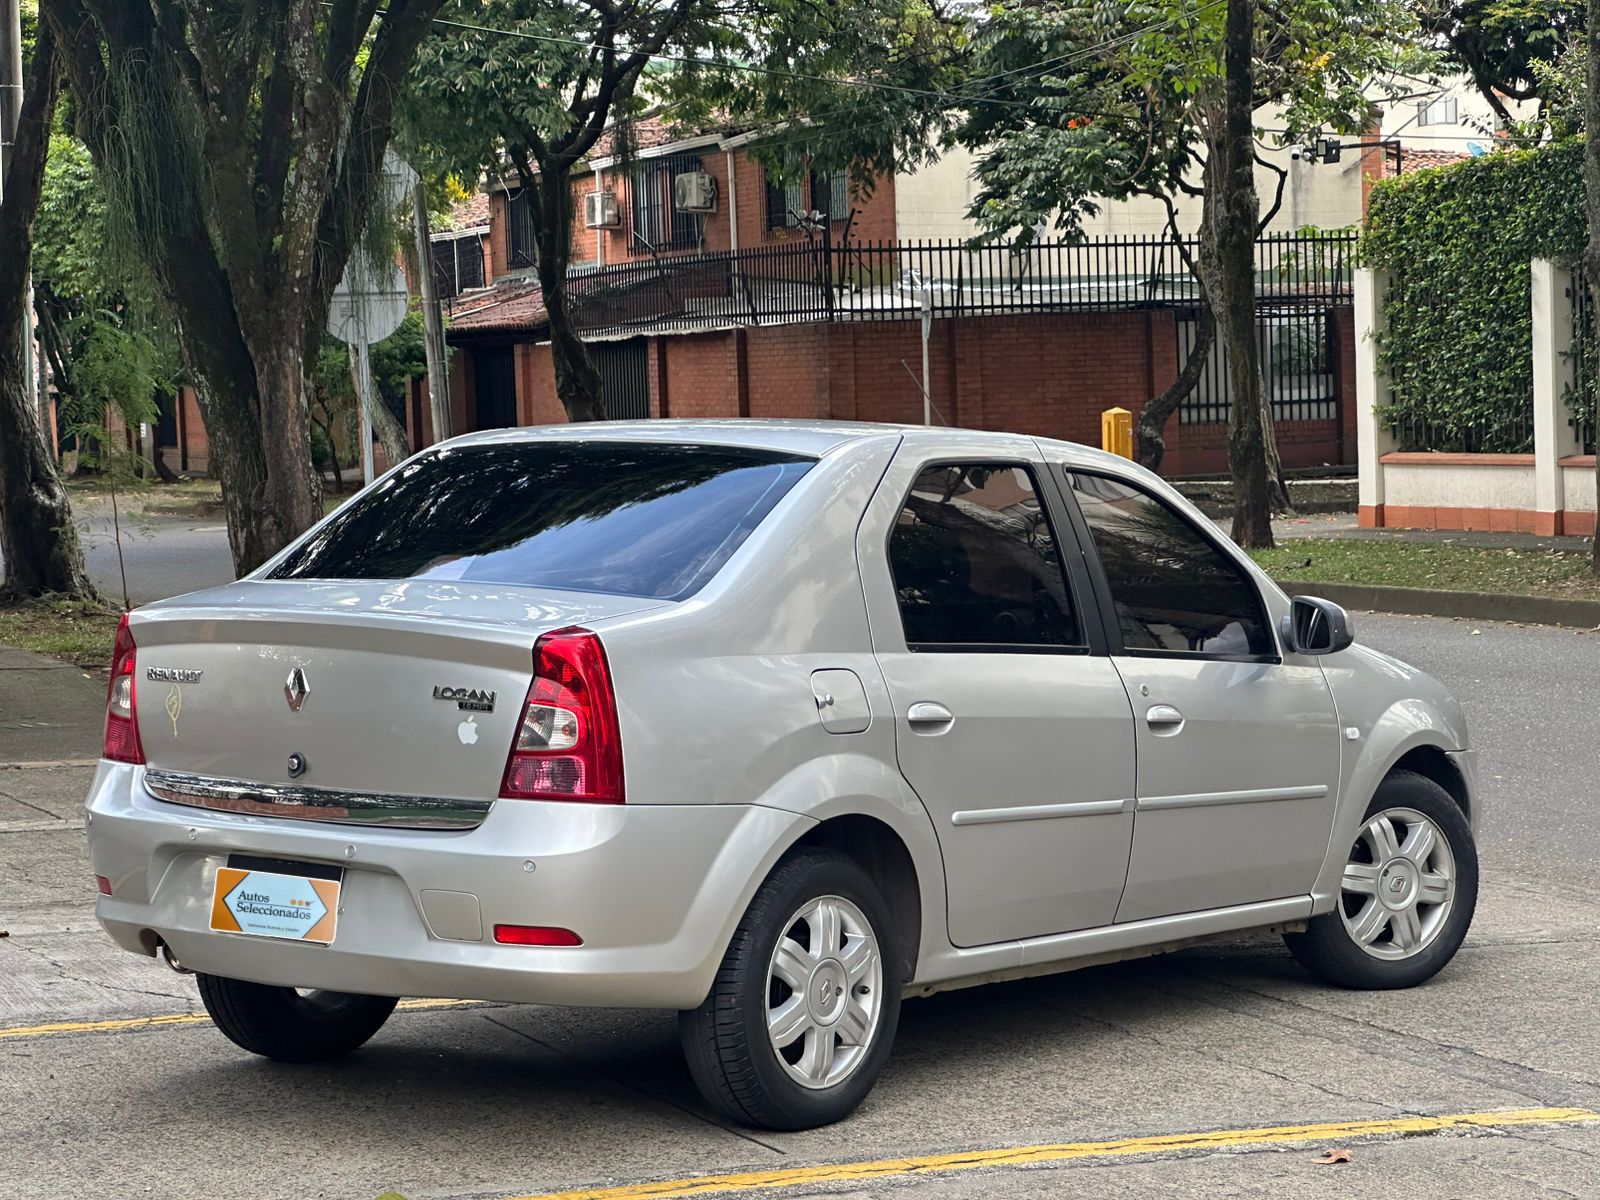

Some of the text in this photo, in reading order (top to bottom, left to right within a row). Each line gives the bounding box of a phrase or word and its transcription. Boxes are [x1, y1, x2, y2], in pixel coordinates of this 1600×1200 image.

[147, 667, 203, 684] RENAULT
[433, 685, 497, 703] LOGAN
[237, 890, 270, 903] Autos
[236, 902, 311, 920] Seleccionados
